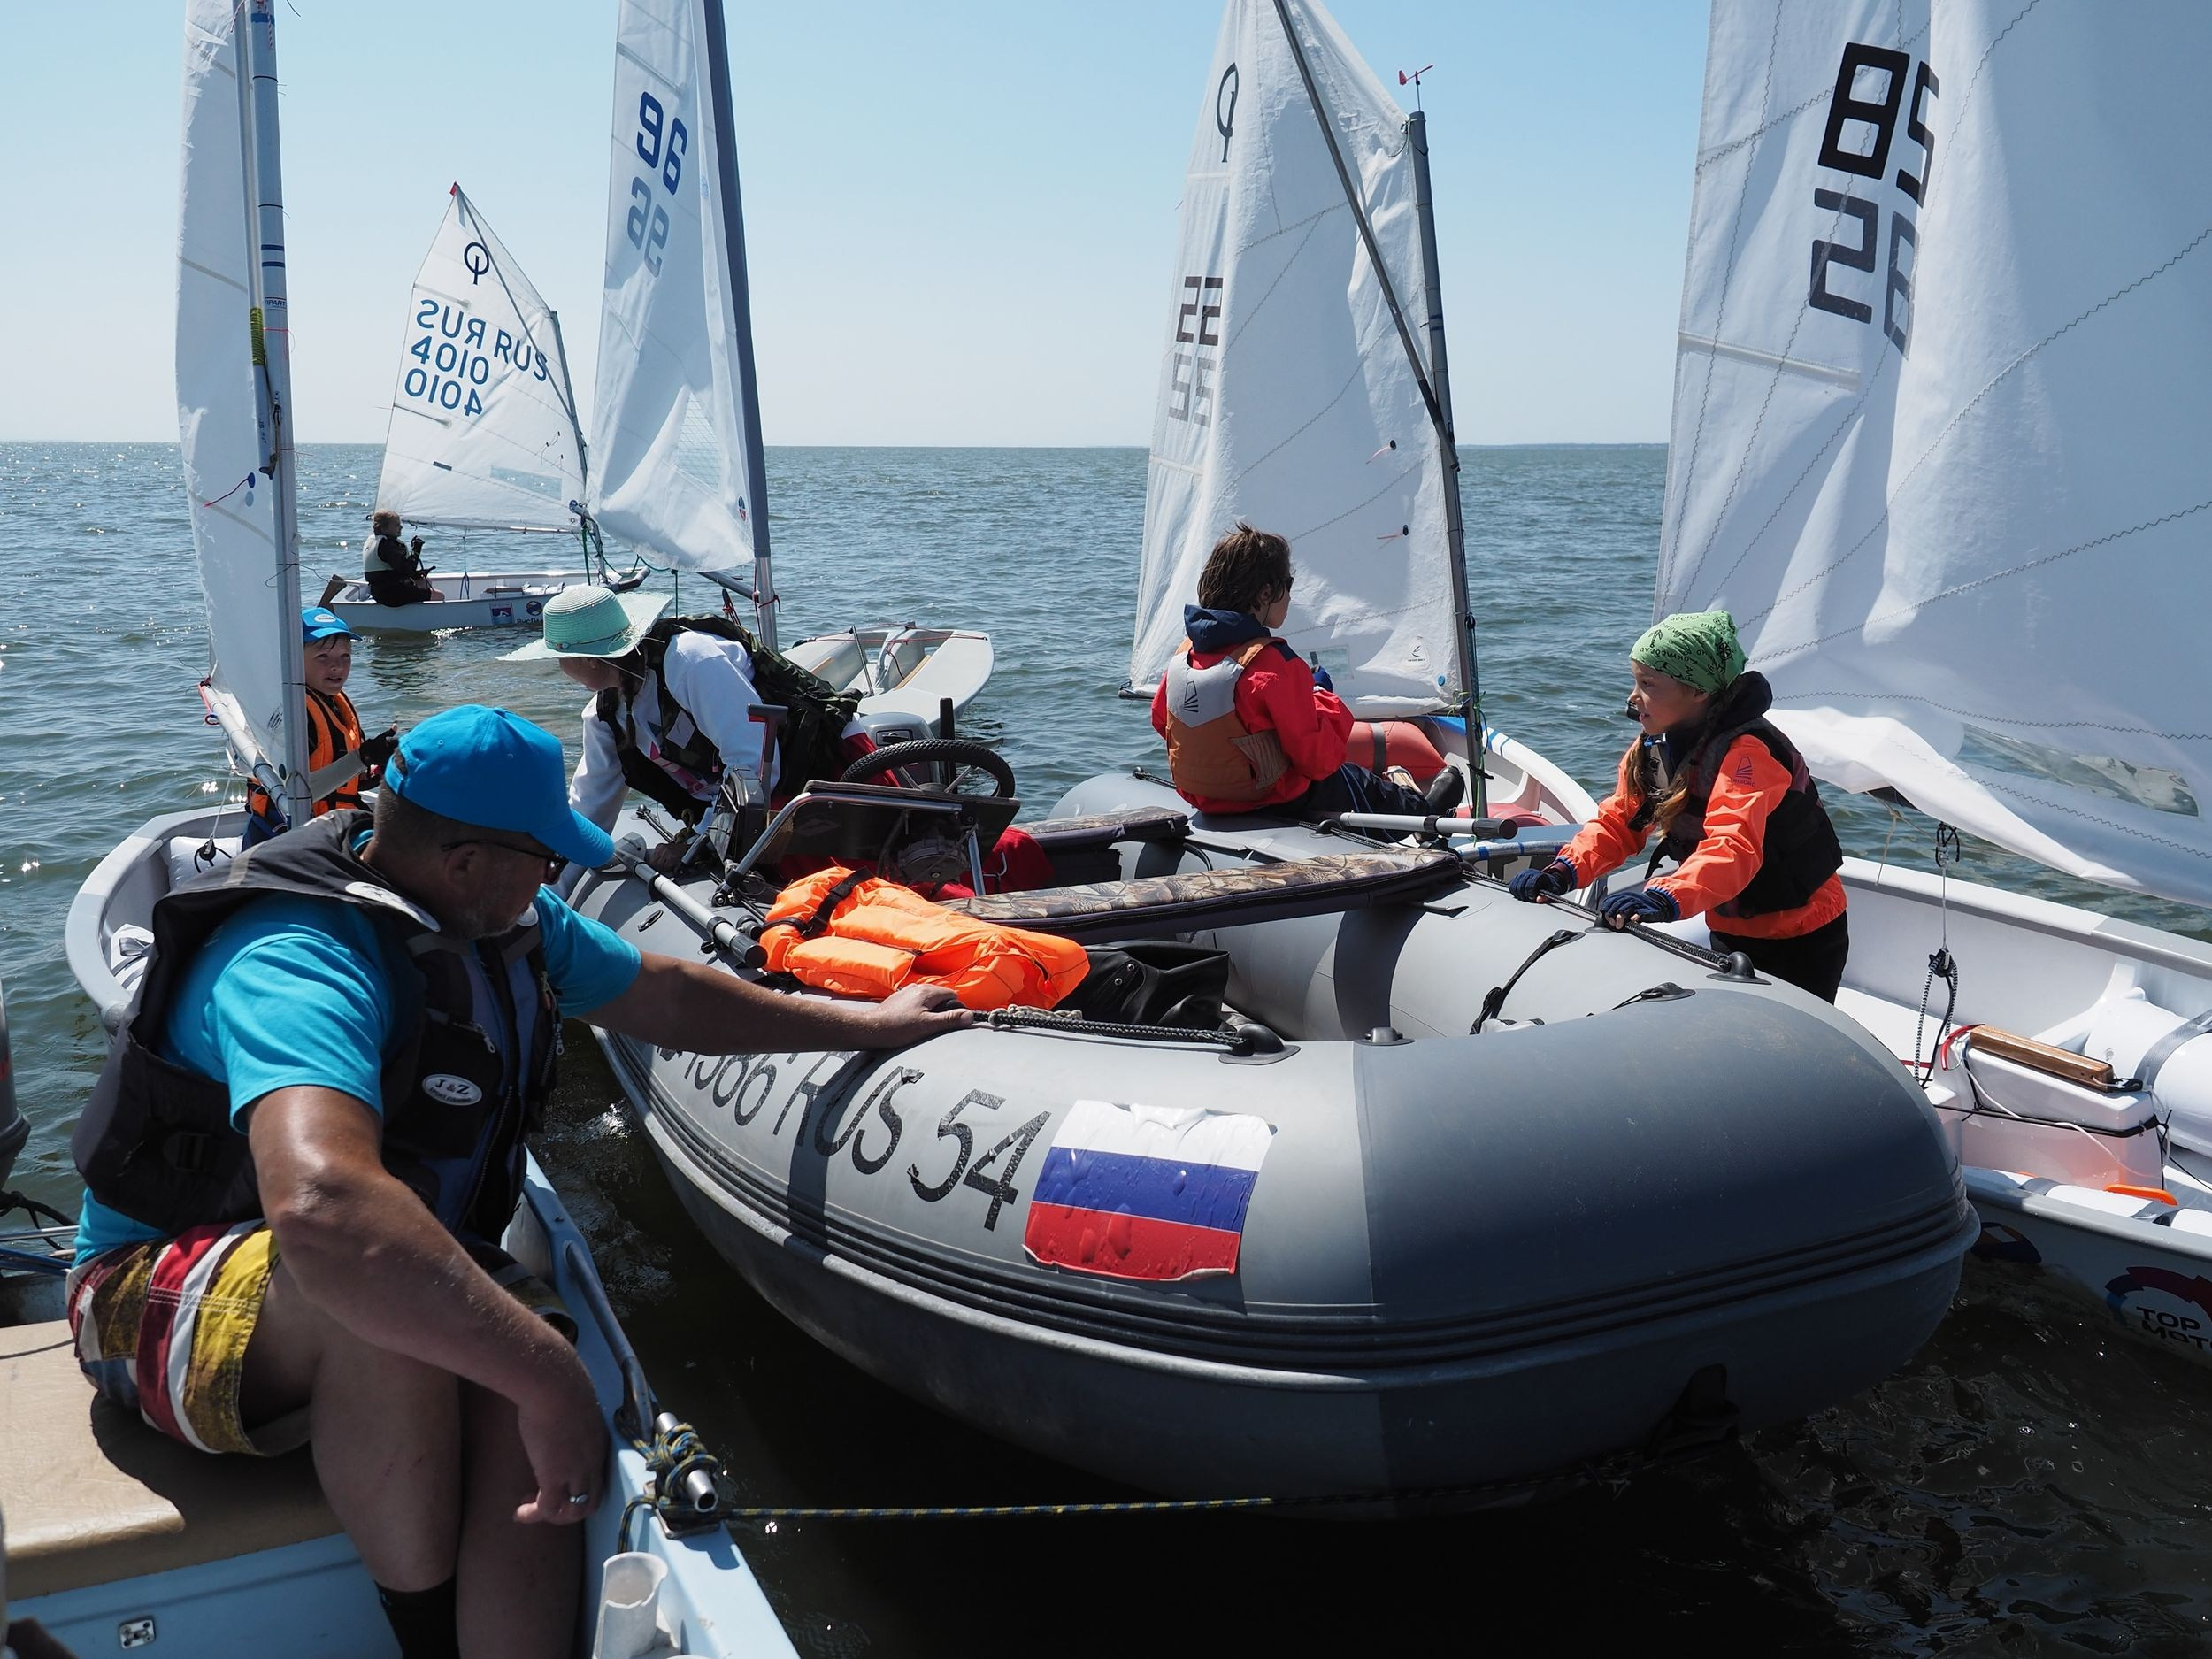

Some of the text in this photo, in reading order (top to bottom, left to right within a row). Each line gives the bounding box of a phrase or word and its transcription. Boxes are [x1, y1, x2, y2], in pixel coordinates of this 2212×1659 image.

[637, 91, 687, 196] 96
[1817, 42, 1939, 209] 85
[1176, 276, 1223, 346] 22
[411, 335, 489, 385] 4010
[494, 328, 548, 382] RUS
[772, 1050, 925, 1176] RUS
[906, 1088, 1052, 1233] 54
[2136, 1306, 2201, 1332] TOP
[2142, 1320, 2212, 1350] MOT
